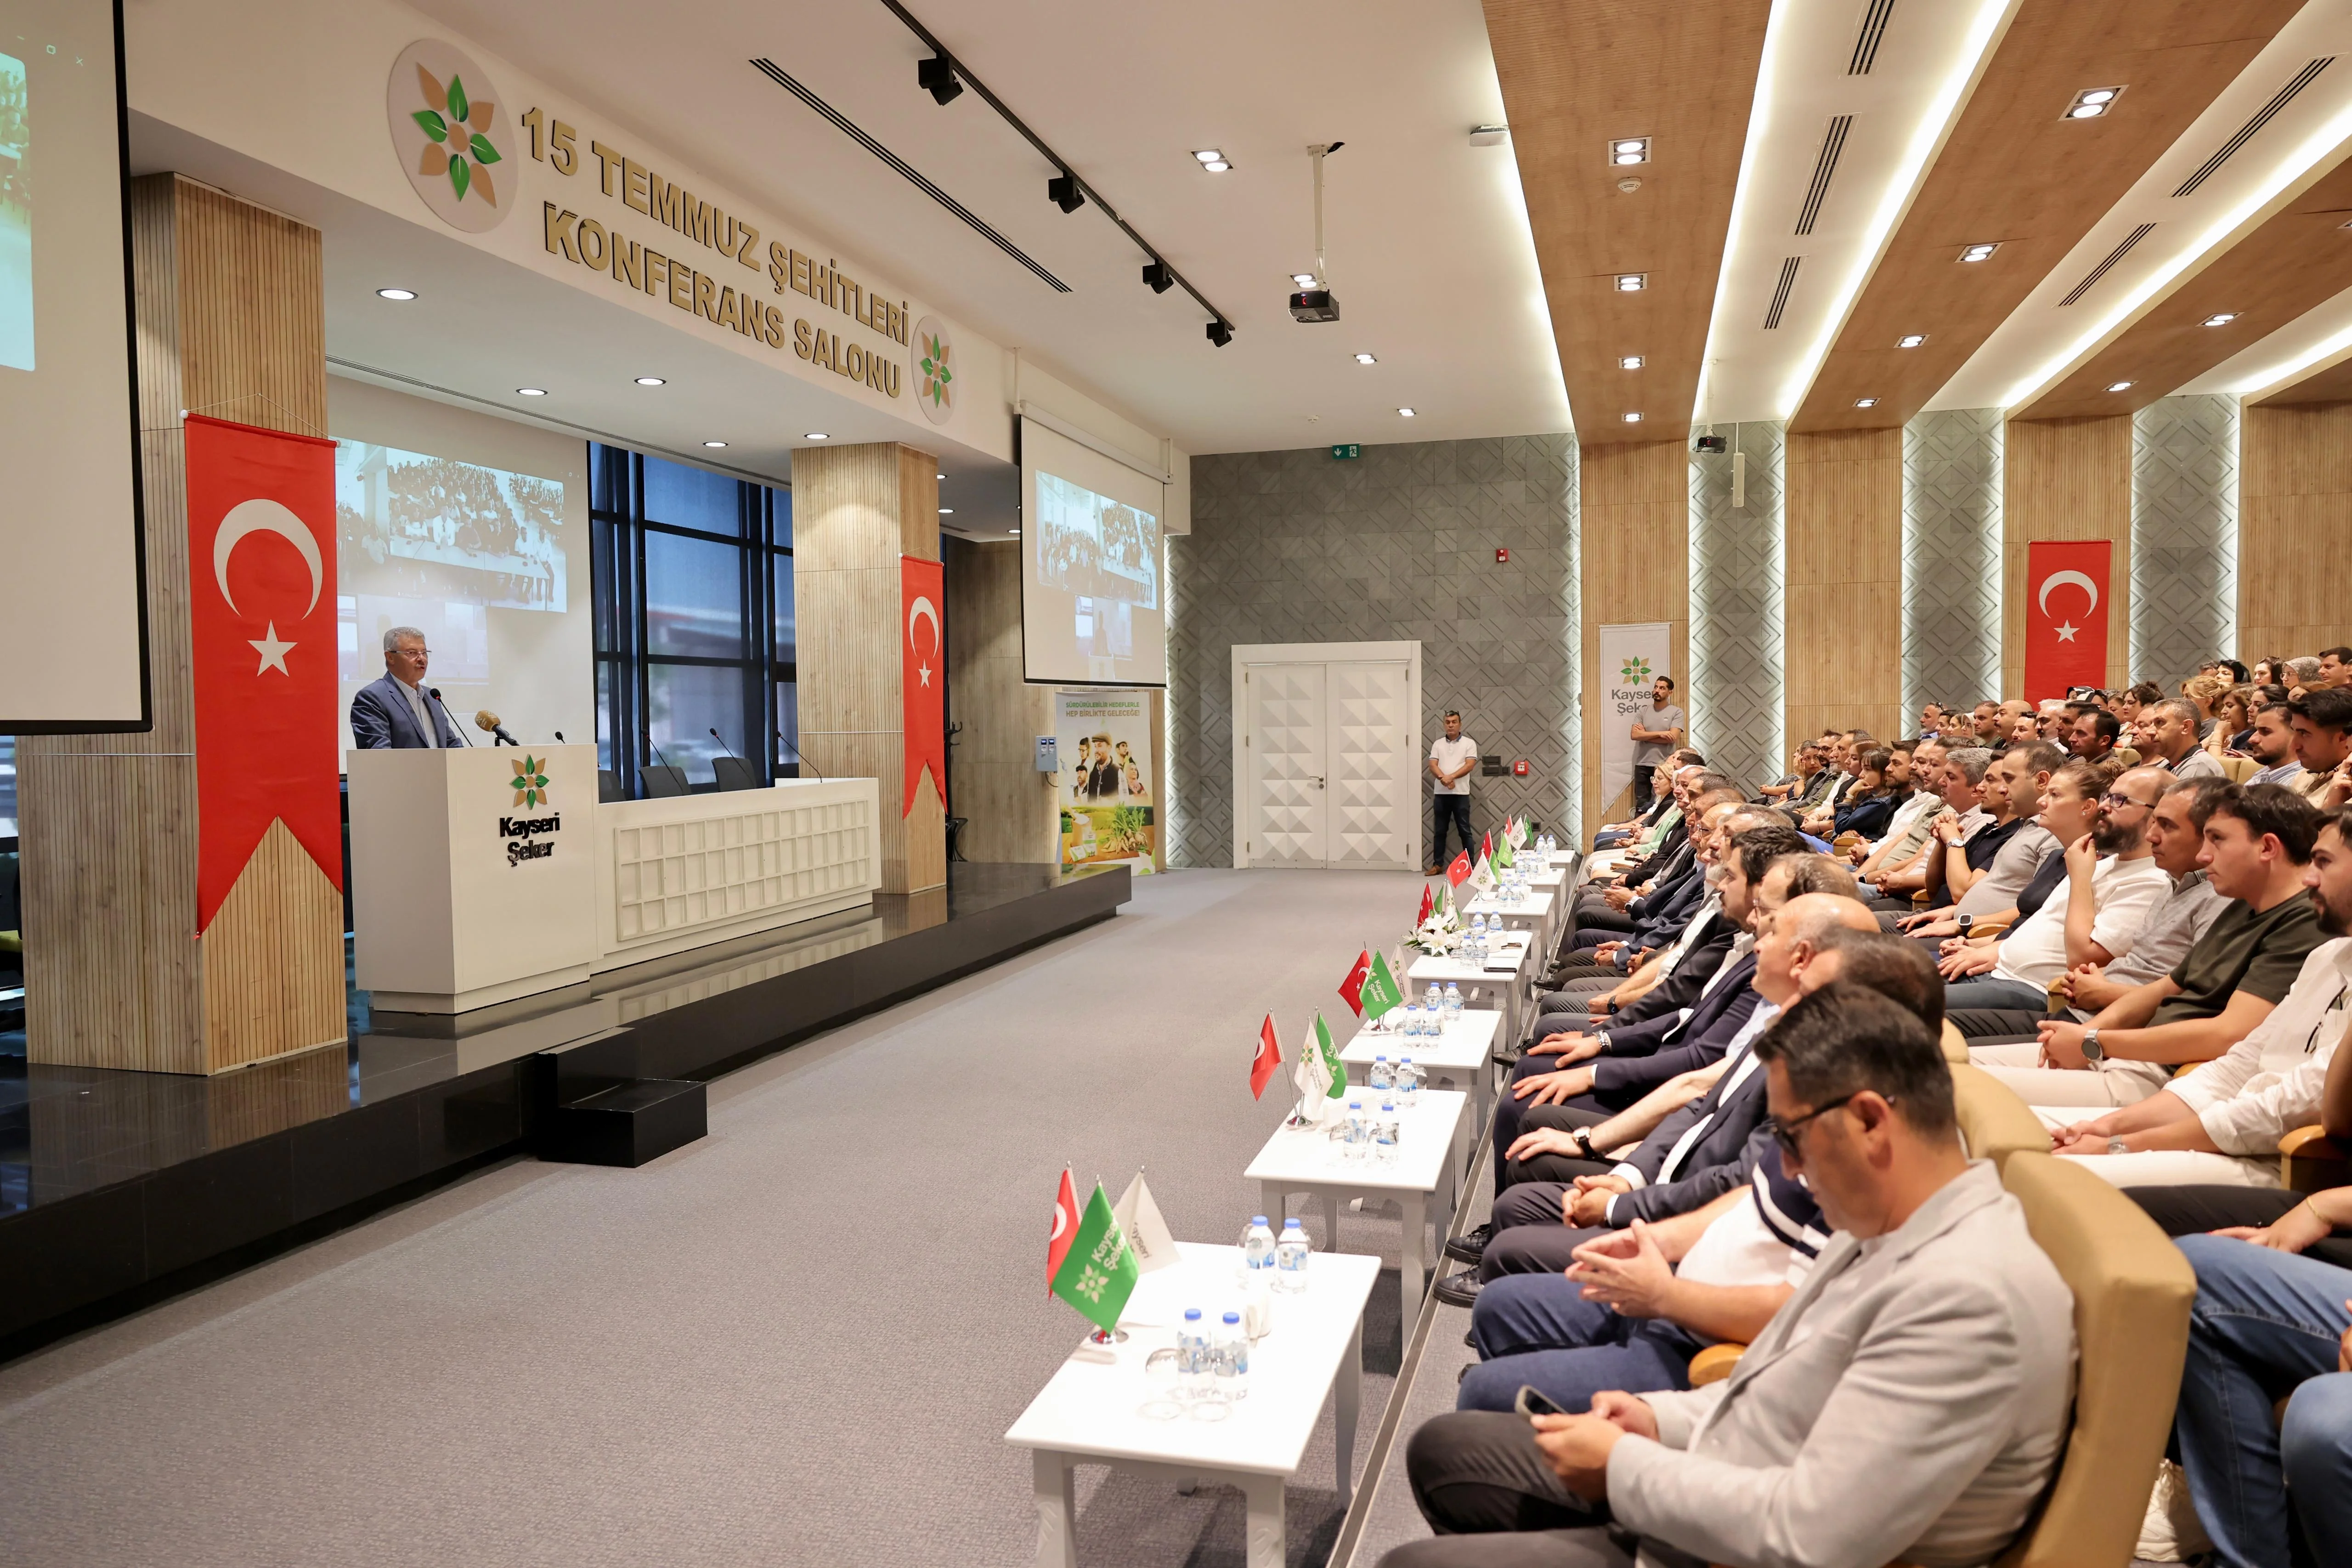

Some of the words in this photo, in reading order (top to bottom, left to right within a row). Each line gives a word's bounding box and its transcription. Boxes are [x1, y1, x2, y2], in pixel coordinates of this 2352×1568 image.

[522, 107, 578, 177] 15
[592, 140, 760, 272] TEMMUZ
[769, 241, 909, 347] ŞEHİTLERİ
[543, 201, 785, 349] KONFERANS
[793, 318, 900, 399] SALONU
[1611, 689, 1654, 702] Kayse
[1617, 702, 1648, 716] Şek
[499, 812, 560, 839] Kayseri
[507, 840, 555, 867] Şeker
[1367, 983, 1381, 1002] Şeker
[1374, 979, 1390, 1004] Kayseri
[1091, 1215, 1119, 1263] Kayse
[1103, 1232, 1126, 1271] Şeke
[1131, 1222, 1153, 1259] ayseri
